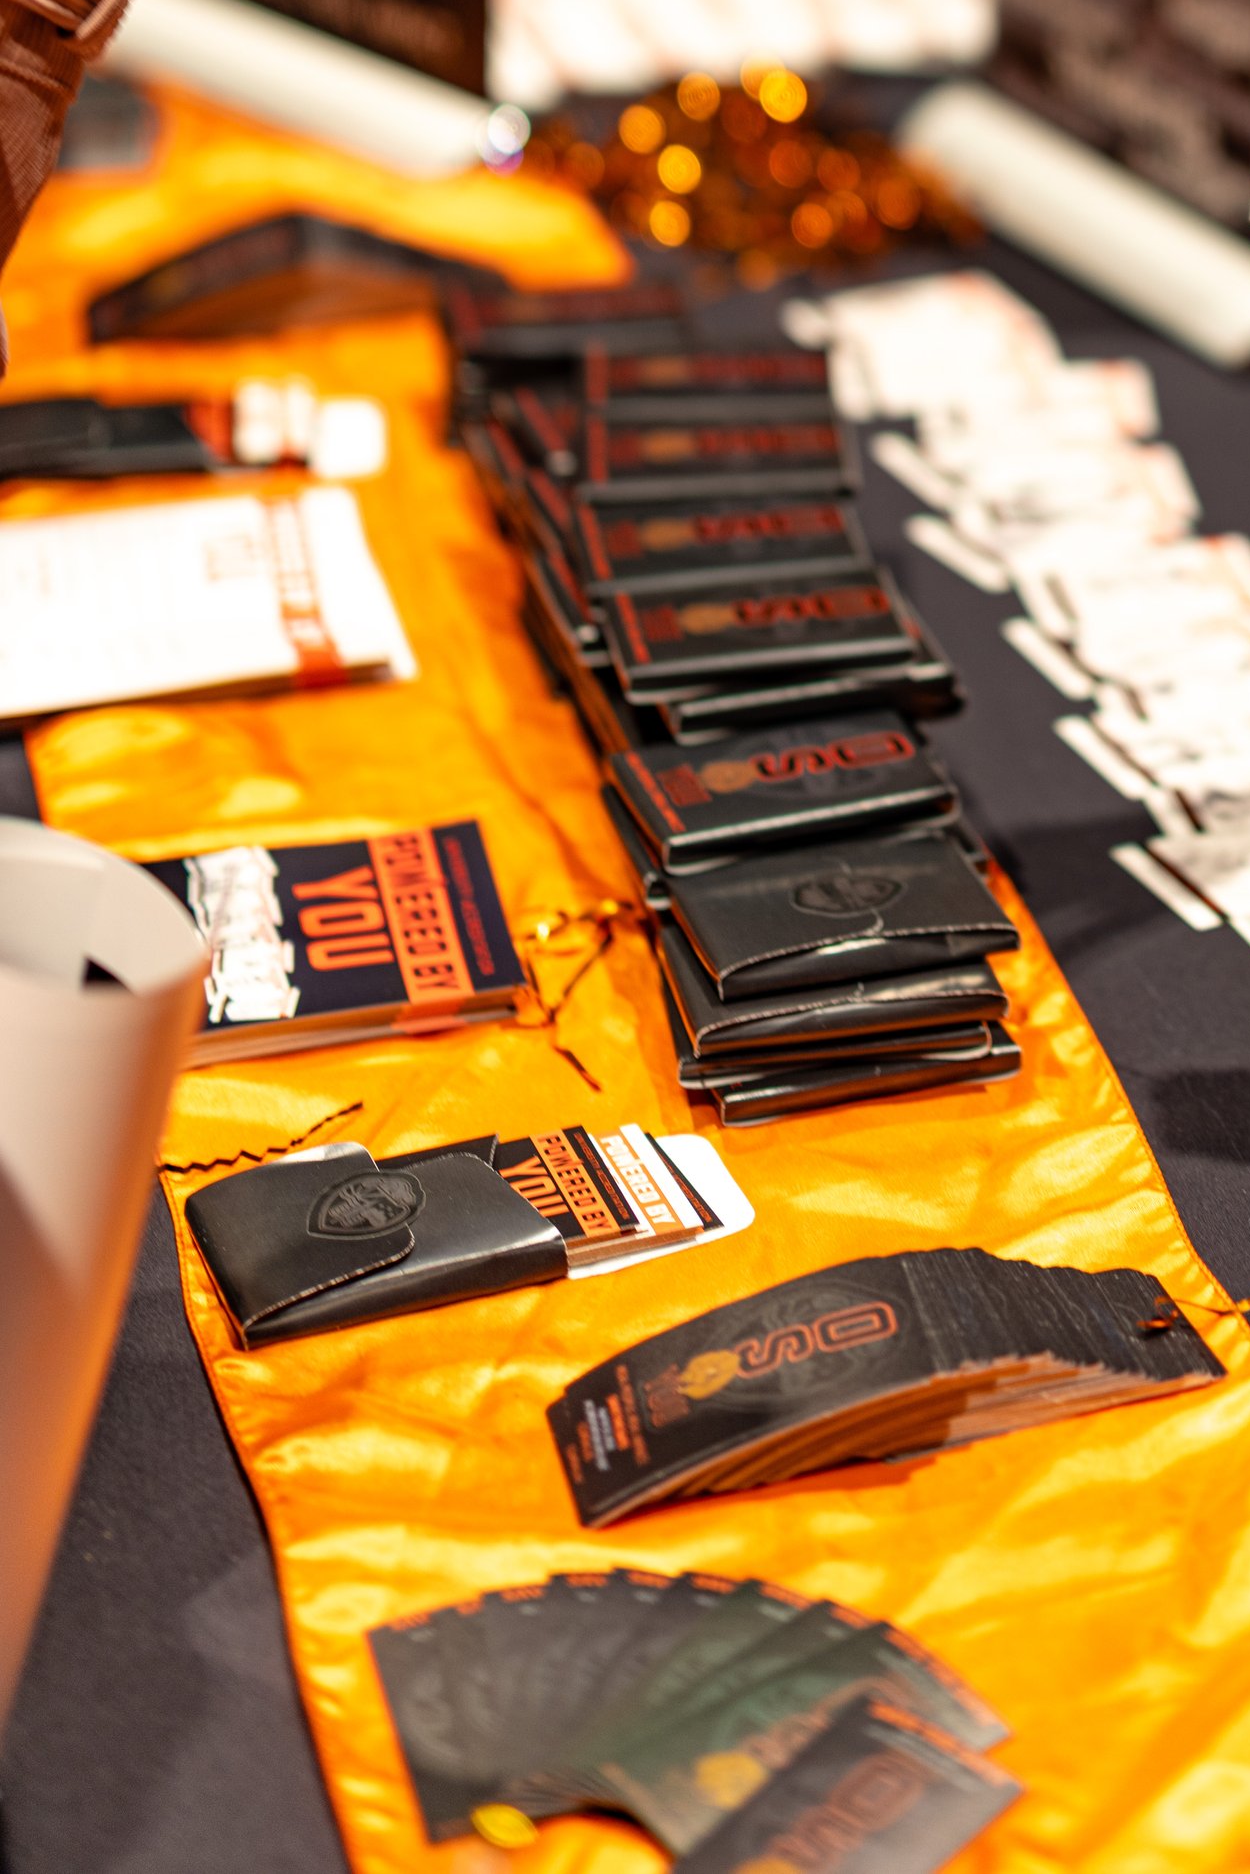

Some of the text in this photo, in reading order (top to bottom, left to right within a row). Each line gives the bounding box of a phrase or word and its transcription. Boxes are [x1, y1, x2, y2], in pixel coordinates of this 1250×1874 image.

[291, 865, 395, 972] YOU
[384, 835, 461, 993] POWERED BY
[498, 1154, 570, 1218] YOU
[537, 1133, 612, 1230] POWERED BY
[600, 1135, 661, 1204] POWERED
[645, 1203, 677, 1224] BY
